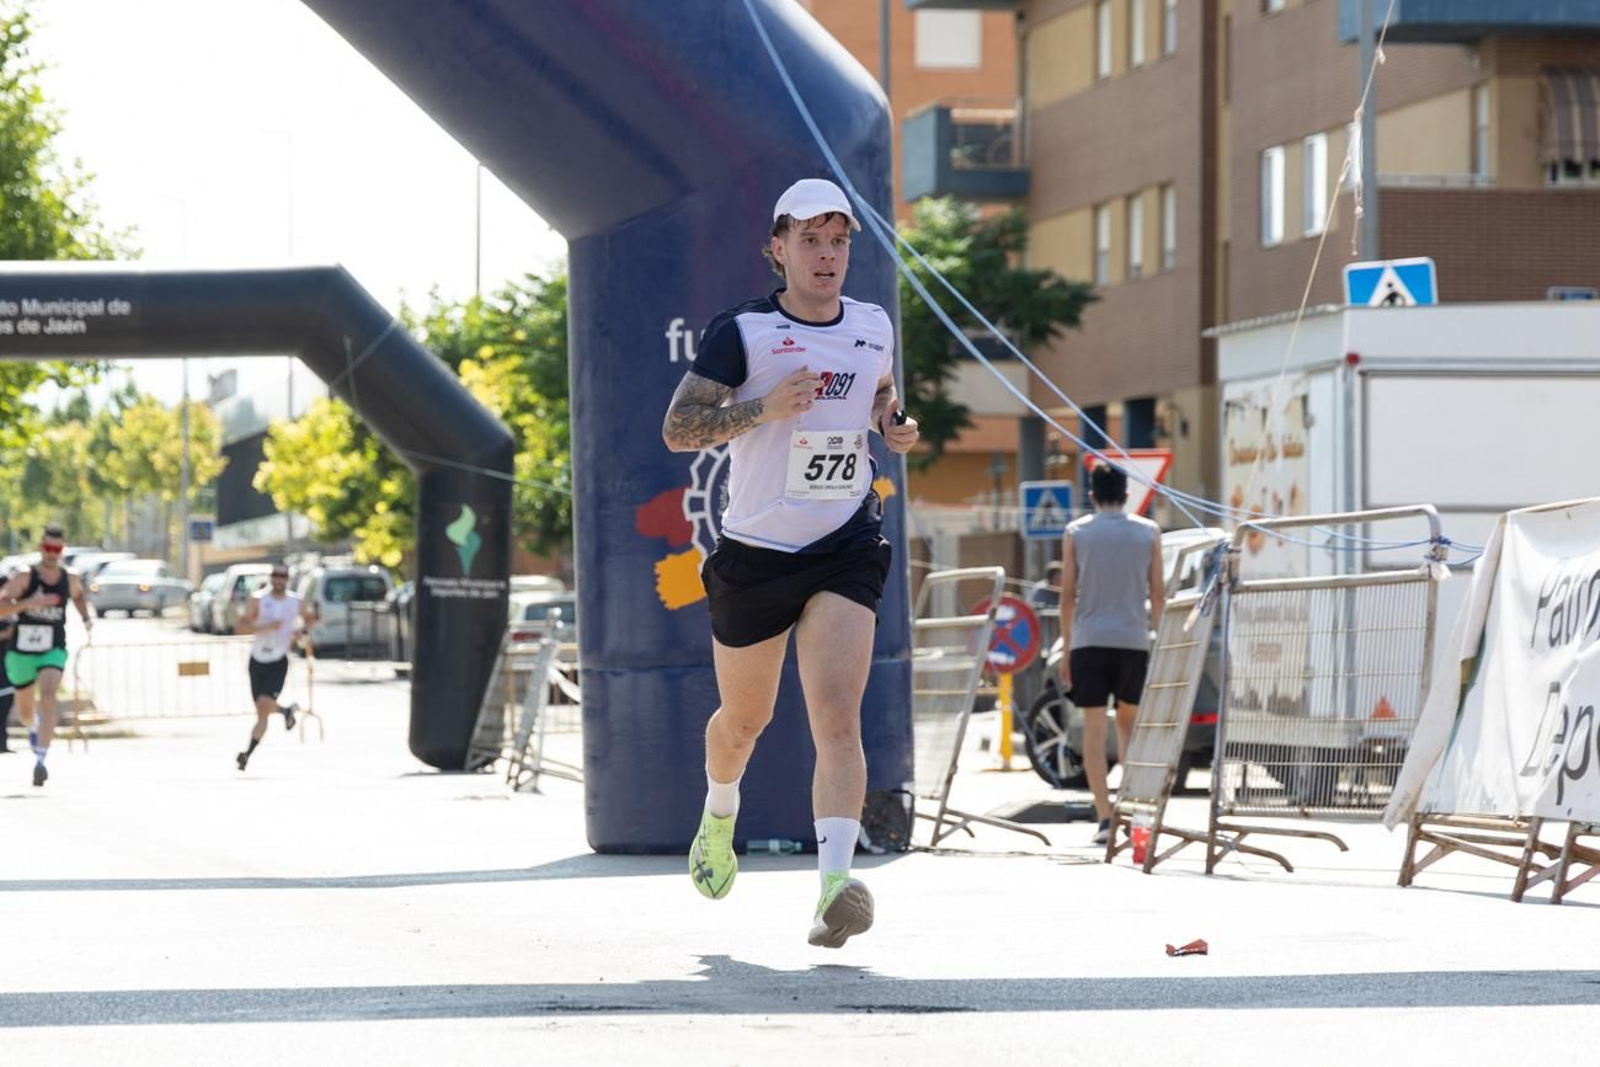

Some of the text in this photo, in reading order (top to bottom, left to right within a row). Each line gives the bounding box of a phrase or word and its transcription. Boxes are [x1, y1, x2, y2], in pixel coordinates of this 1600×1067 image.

[22, 298, 104, 319] Municipal
[107, 298, 131, 316] de
[17, 317, 41, 335] de
[43, 315, 87, 335] Jaén
[771, 346, 807, 355] Santander
[804, 452, 857, 482] 578
[1519, 681, 1600, 806] Dep
